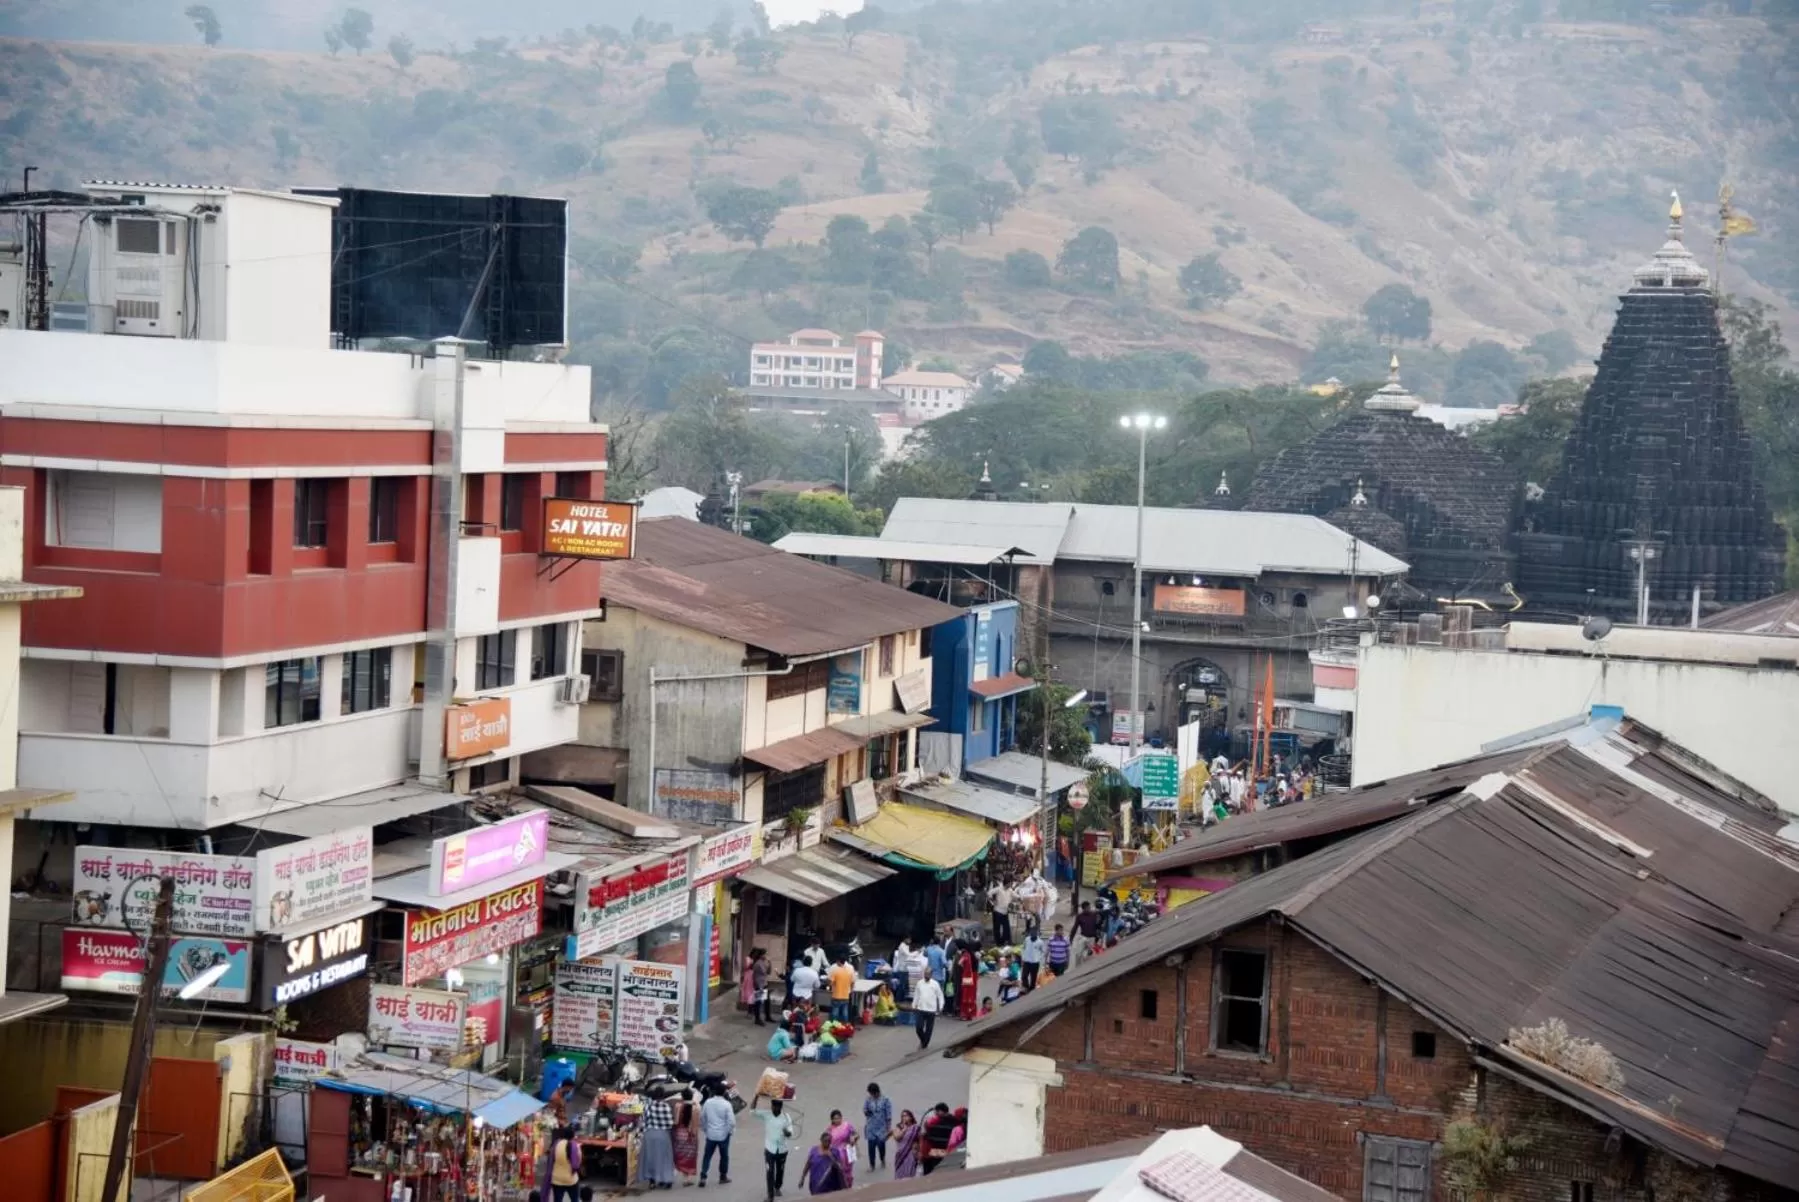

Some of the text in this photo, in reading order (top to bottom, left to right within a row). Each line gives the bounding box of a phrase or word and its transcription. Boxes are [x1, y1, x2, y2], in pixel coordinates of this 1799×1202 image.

[570, 505, 609, 519] HOTEL
[549, 519, 629, 538] SAI YATRI
[81, 855, 113, 883] साई
[116, 858, 154, 882] यात्री
[222, 863, 253, 890] हॉल
[286, 919, 363, 973] SAI YATRI
[275, 976, 311, 1002] ROOMS
[623, 973, 679, 989] भोजनालय
[376, 994, 458, 1023] साई यात्री
